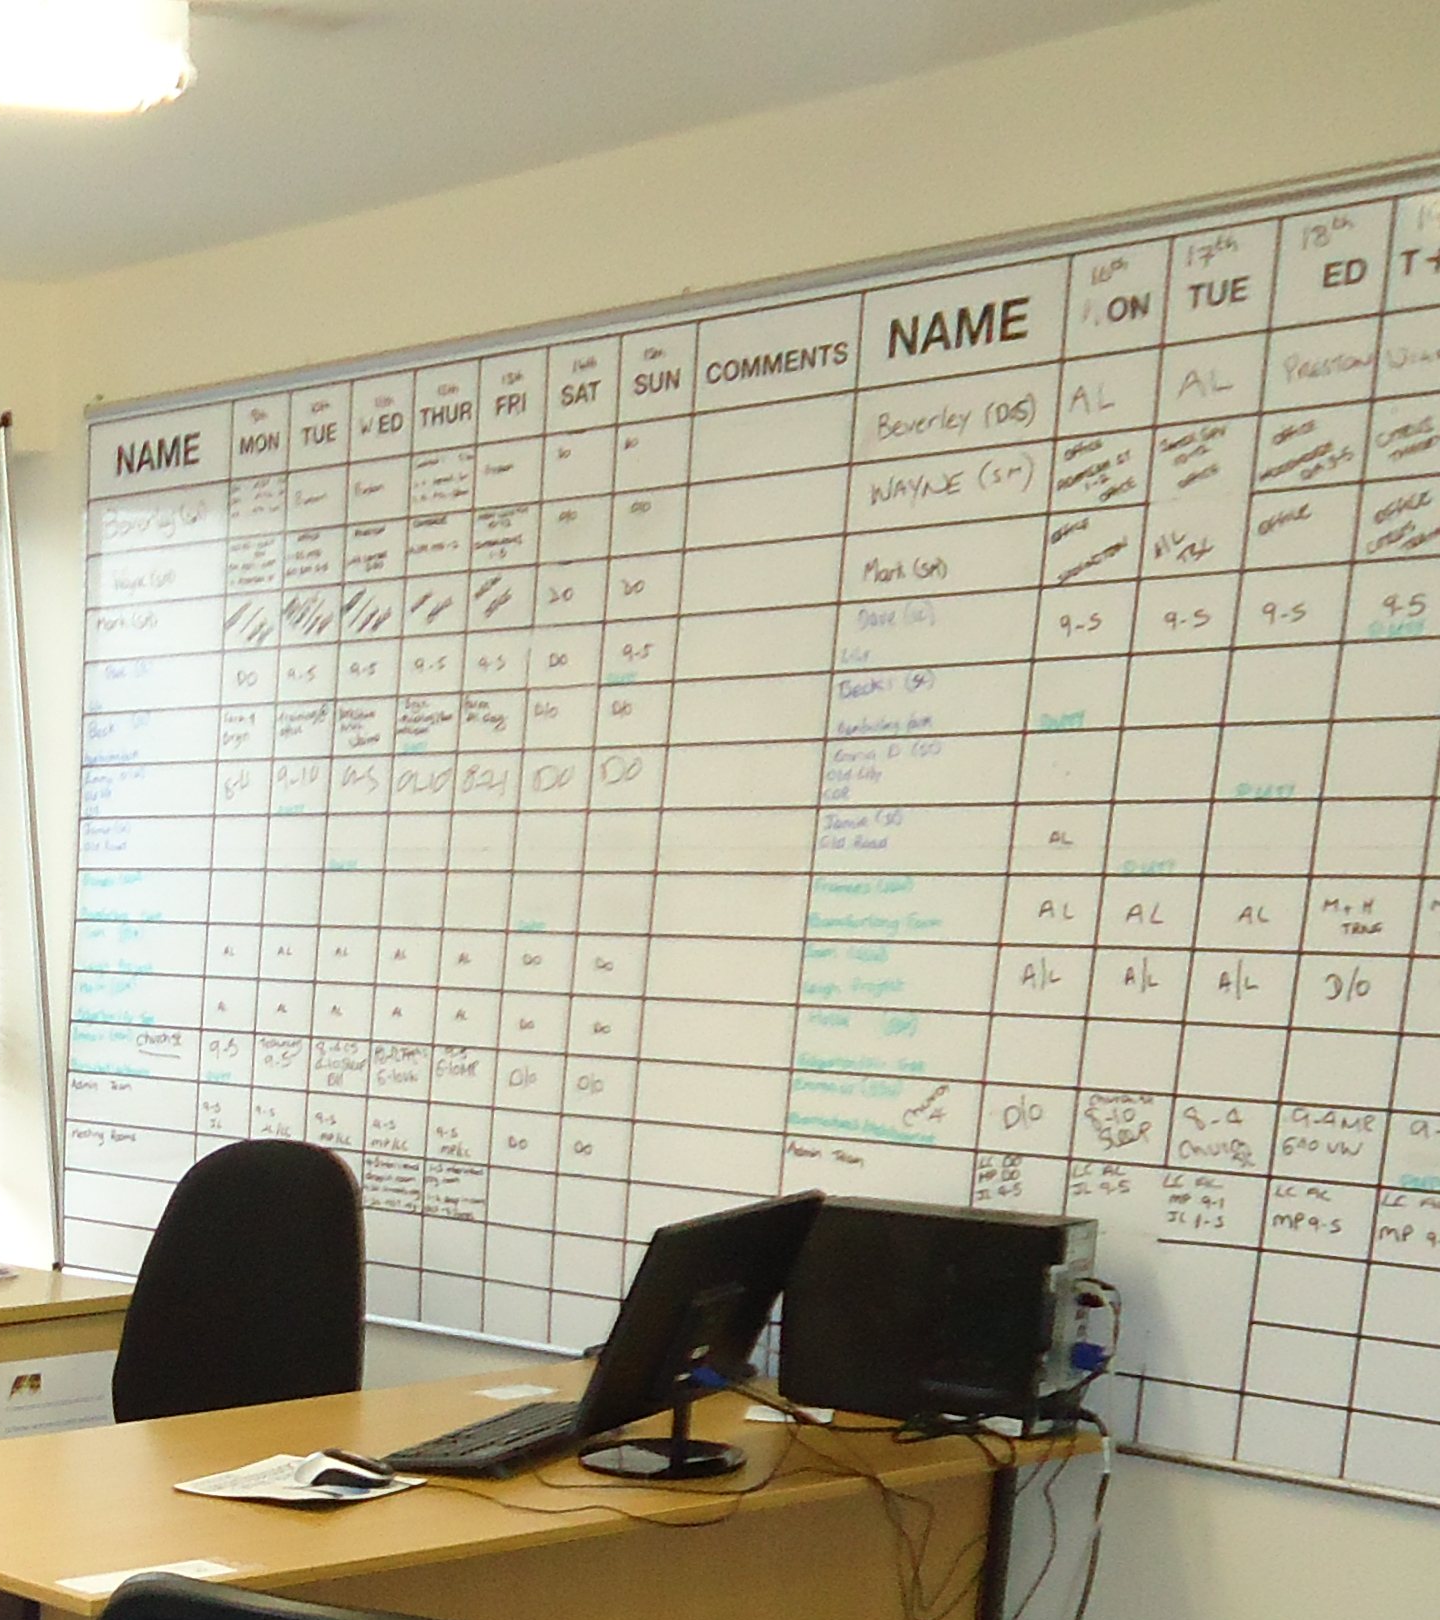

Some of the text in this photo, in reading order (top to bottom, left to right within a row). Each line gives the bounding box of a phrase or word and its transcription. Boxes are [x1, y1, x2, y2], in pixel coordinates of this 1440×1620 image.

[1187, 275, 1250, 310] TUE
[887, 296, 1032, 360] NAME
[705, 341, 849, 385] COMMENTS
[560, 380, 602, 408] SAT
[633, 368, 682, 396] SUN
[1177, 369, 1235, 399] AL
[494, 392, 527, 416] FRI
[1069, 382, 1116, 415] AL
[419, 401, 472, 427] THUR
[239, 431, 280, 456] MON
[302, 422, 338, 445] TUE
[115, 431, 202, 478] NAME
[1164, 608, 1211, 631] 9-5
[1262, 600, 1307, 625] 9-5
[1038, 899, 1075, 921] AL
[1125, 903, 1165, 926] AL
[1237, 904, 1270, 924] AL
